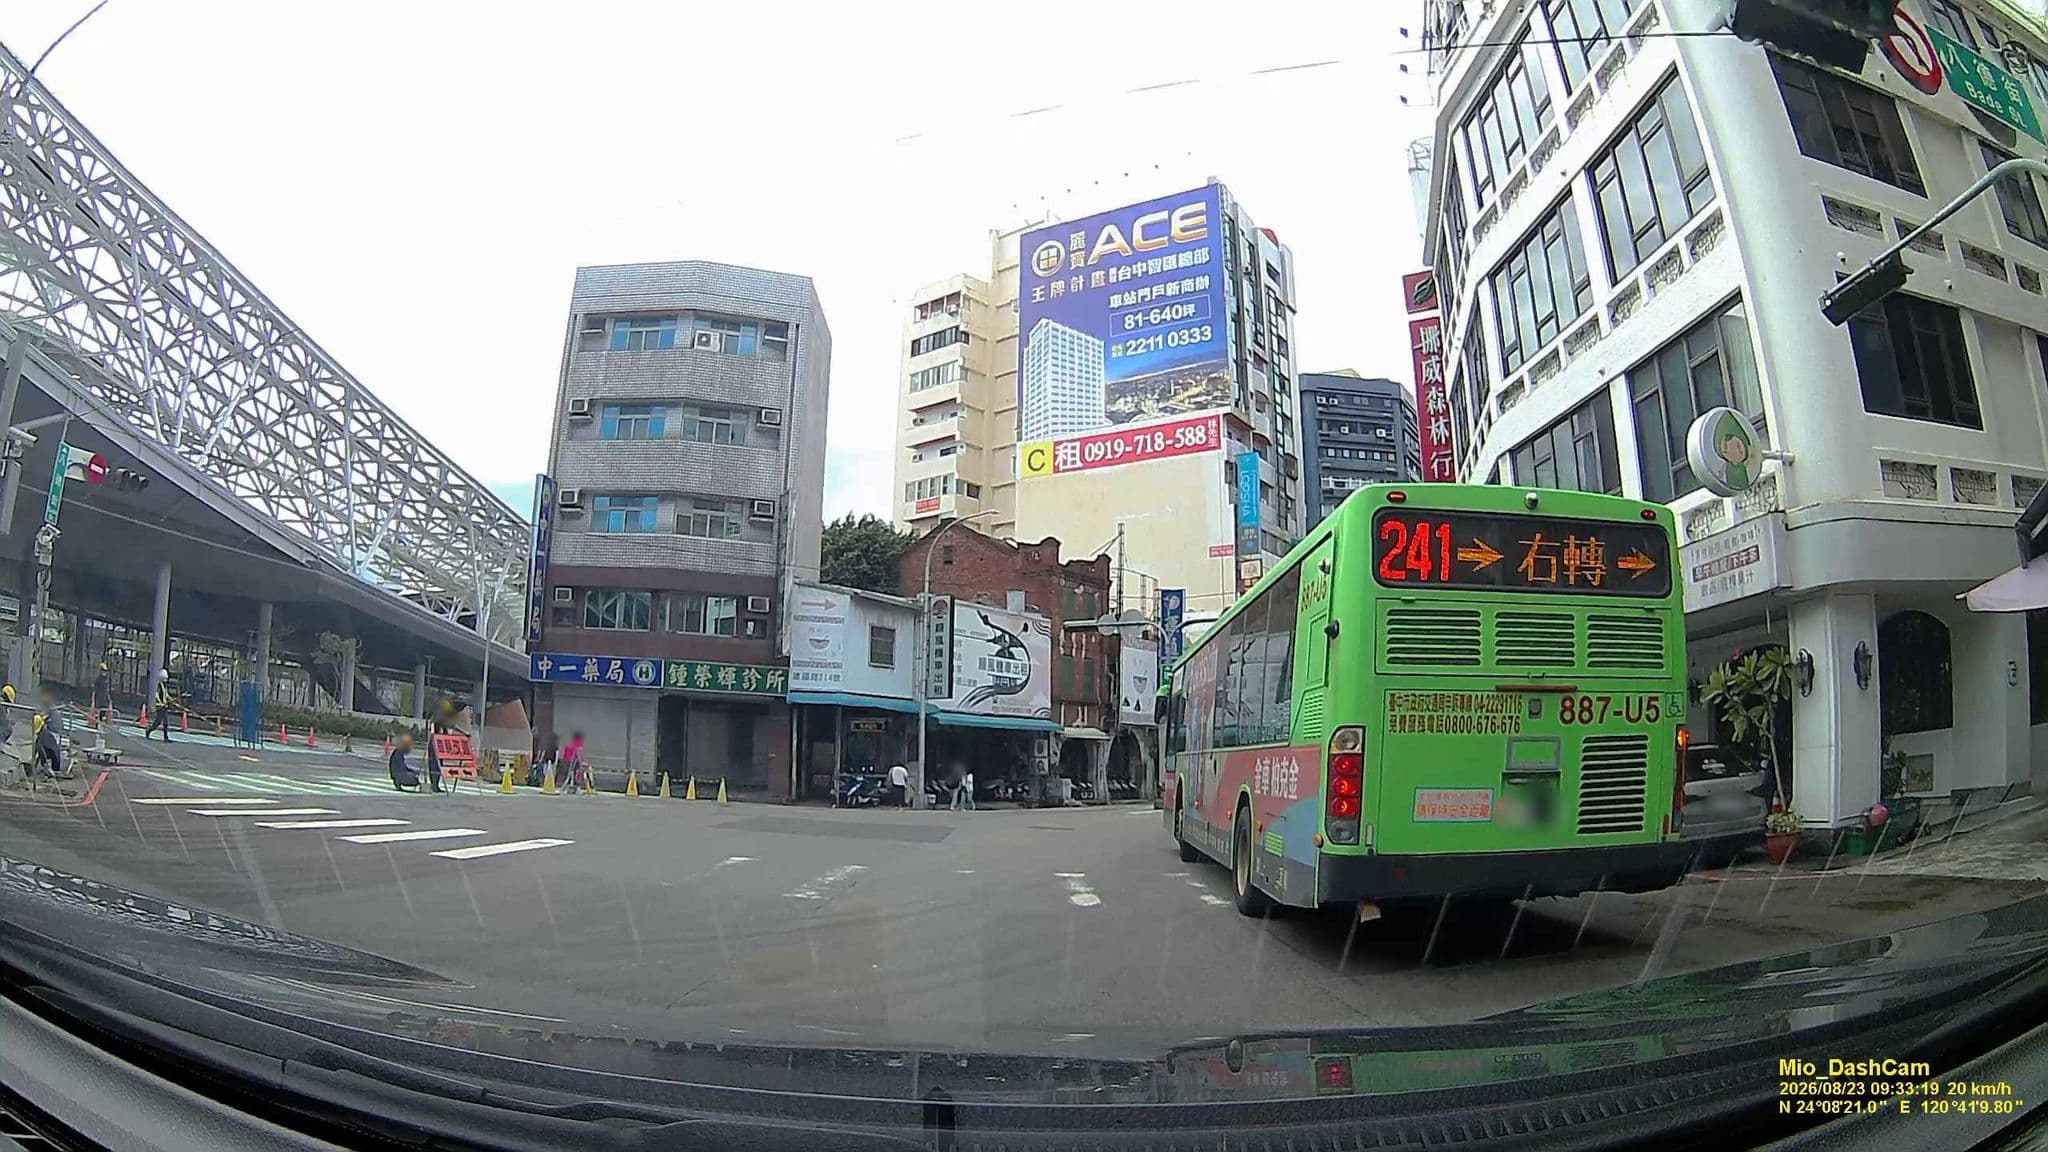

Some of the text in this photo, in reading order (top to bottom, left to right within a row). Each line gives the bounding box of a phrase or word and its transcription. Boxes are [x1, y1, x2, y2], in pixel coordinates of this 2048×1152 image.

[1940, 43, 2022, 107] 八德街
[1965, 81, 2003, 113] Bade
[1087, 202, 1208, 265] ACE
[1069, 231, 1086, 270] 麗寶
[1031, 270, 1106, 303] 王牌計畫
[1109, 275, 1210, 308] 車站門戶新商辦
[1124, 304, 1196, 330] 81-640坪
[1126, 334, 1163, 356] 2211
[1167, 325, 1212, 348] 0333
[1413, 325, 1453, 480] 挪威森林行
[1028, 449, 1045, 472] C
[1055, 425, 1206, 471] 租 0919-718-588
[1378, 519, 1452, 583] 241
[1517, 533, 1608, 587] 右轉
[537, 655, 624, 684] 中一藥局
[668, 662, 786, 693] 鍾榮輝診所
[1559, 696, 1660, 726] 887-U5
